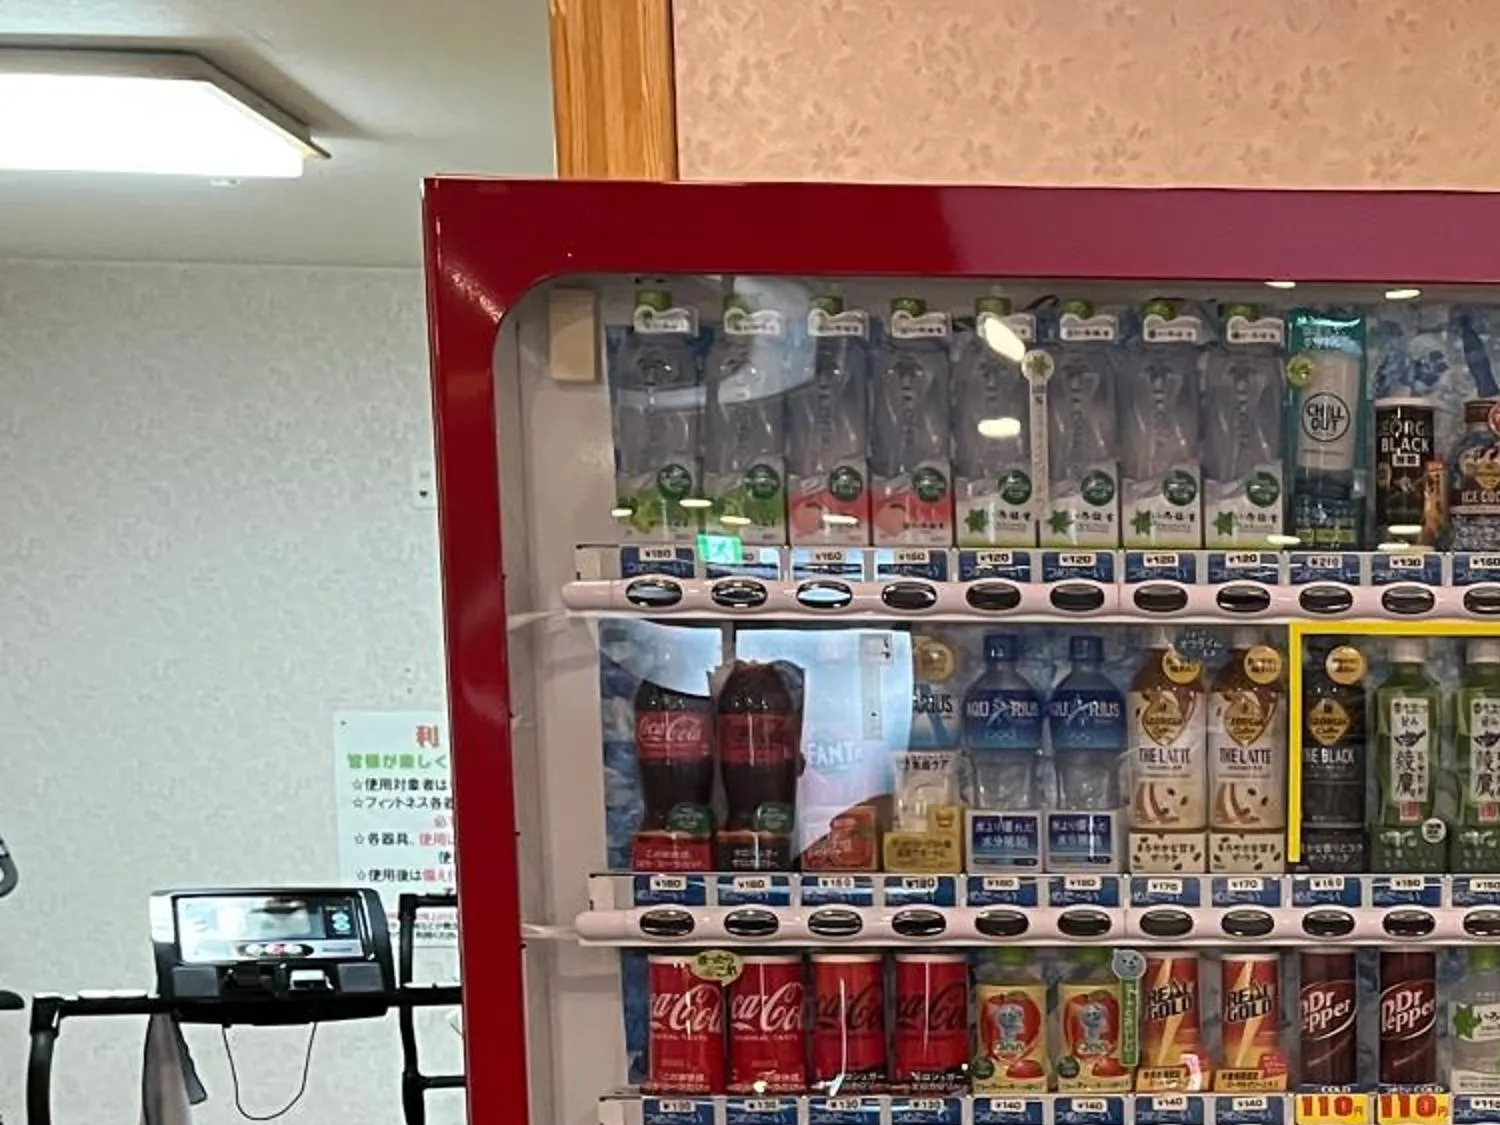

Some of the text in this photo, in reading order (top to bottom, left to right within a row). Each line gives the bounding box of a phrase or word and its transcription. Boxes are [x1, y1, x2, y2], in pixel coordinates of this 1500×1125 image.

[1379, 437, 1430, 453] BLACK
[1321, 748, 1355, 765] BLACK
[1309, 990, 1335, 1013] Dr
[1402, 988, 1425, 1012] Dr
